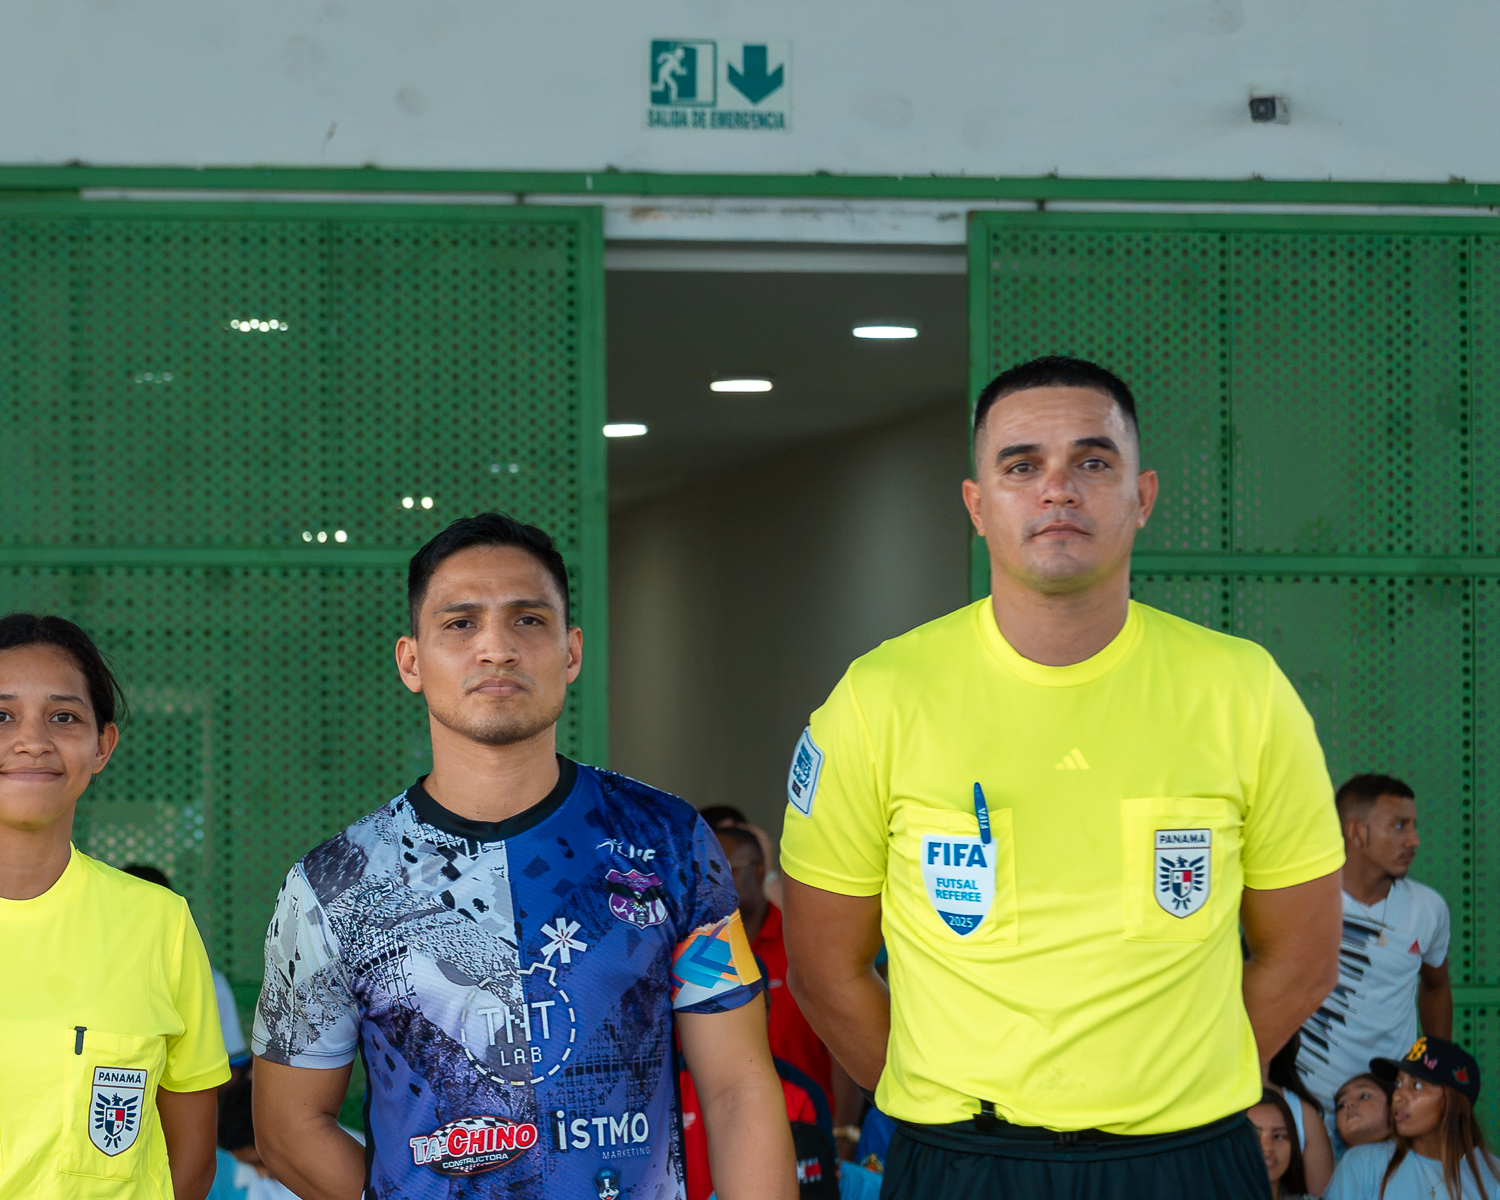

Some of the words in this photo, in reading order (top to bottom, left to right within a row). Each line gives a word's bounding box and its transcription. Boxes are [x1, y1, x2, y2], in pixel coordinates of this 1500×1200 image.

[927, 841, 987, 868] FIFA
[936, 877, 978, 890] FUTSAL
[935, 889, 982, 902] REFEREE
[949, 915, 974, 928] 2025
[477, 1000, 556, 1046] TNT
[501, 1046, 542, 1067] LAB
[98, 1072, 141, 1084] PANAMÁ
[602, 1146, 651, 1160] MARKETING
[442, 1153, 509, 1169] CONSTRUCTORA
